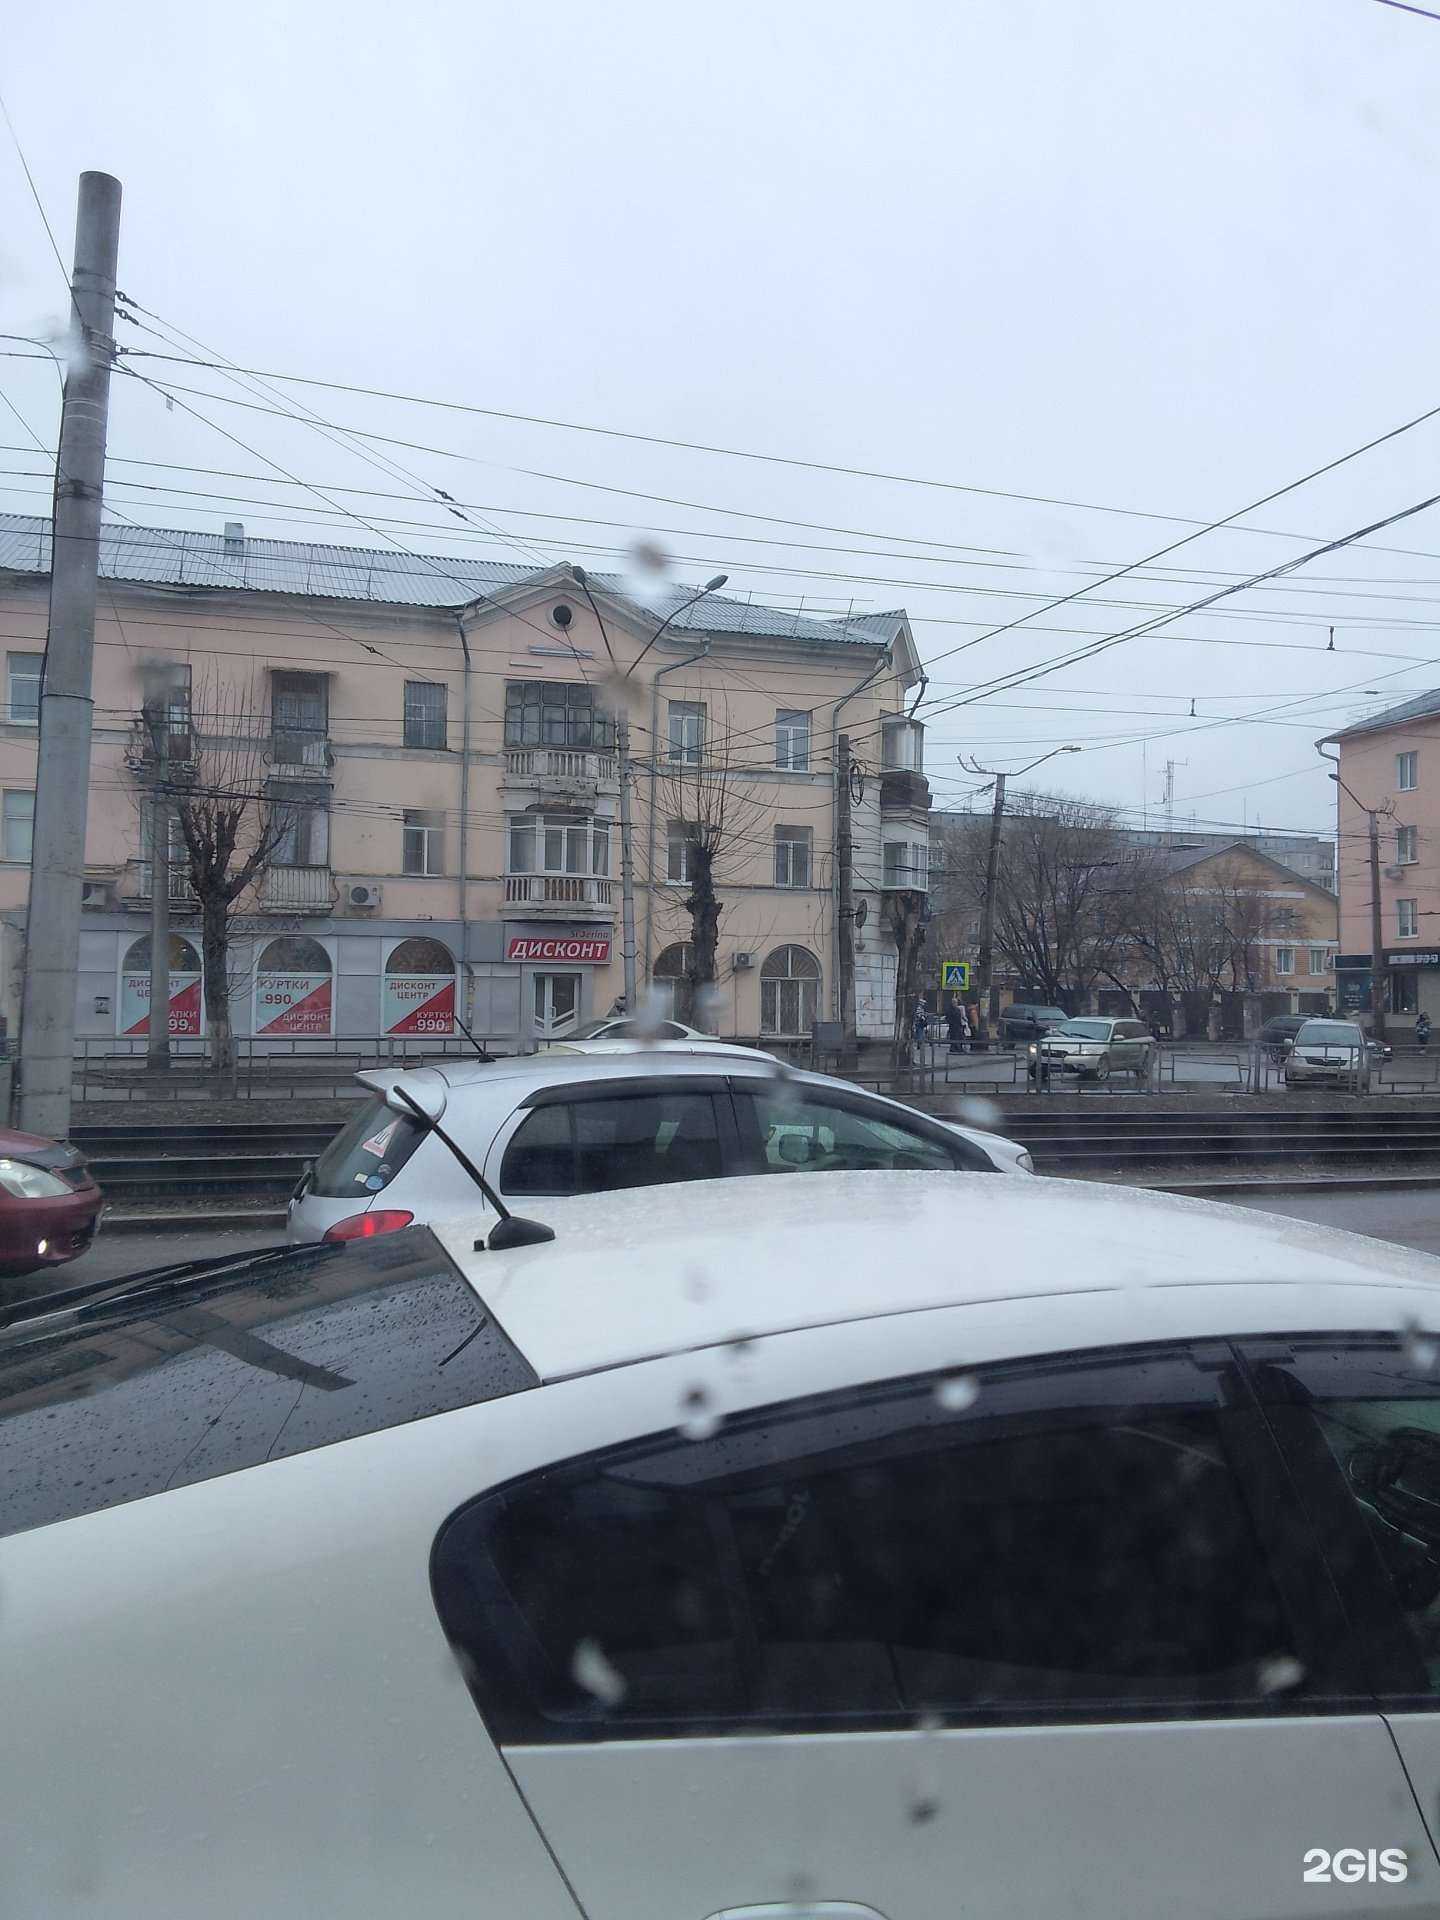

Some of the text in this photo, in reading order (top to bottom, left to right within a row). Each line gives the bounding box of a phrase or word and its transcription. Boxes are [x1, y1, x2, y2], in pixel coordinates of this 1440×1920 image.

[512, 941, 606, 959] ДИСКОНТ
[259, 980, 310, 990] КУРТКИ
[390, 982, 436, 991] ДИСКОНТ
[397, 991, 428, 1000] ЦЕНТР
[169, 1010, 198, 1019] АПКИ
[283, 1012, 329, 1022] ДИСКОНТ
[416, 1011, 452, 1019] КУРТКИ
